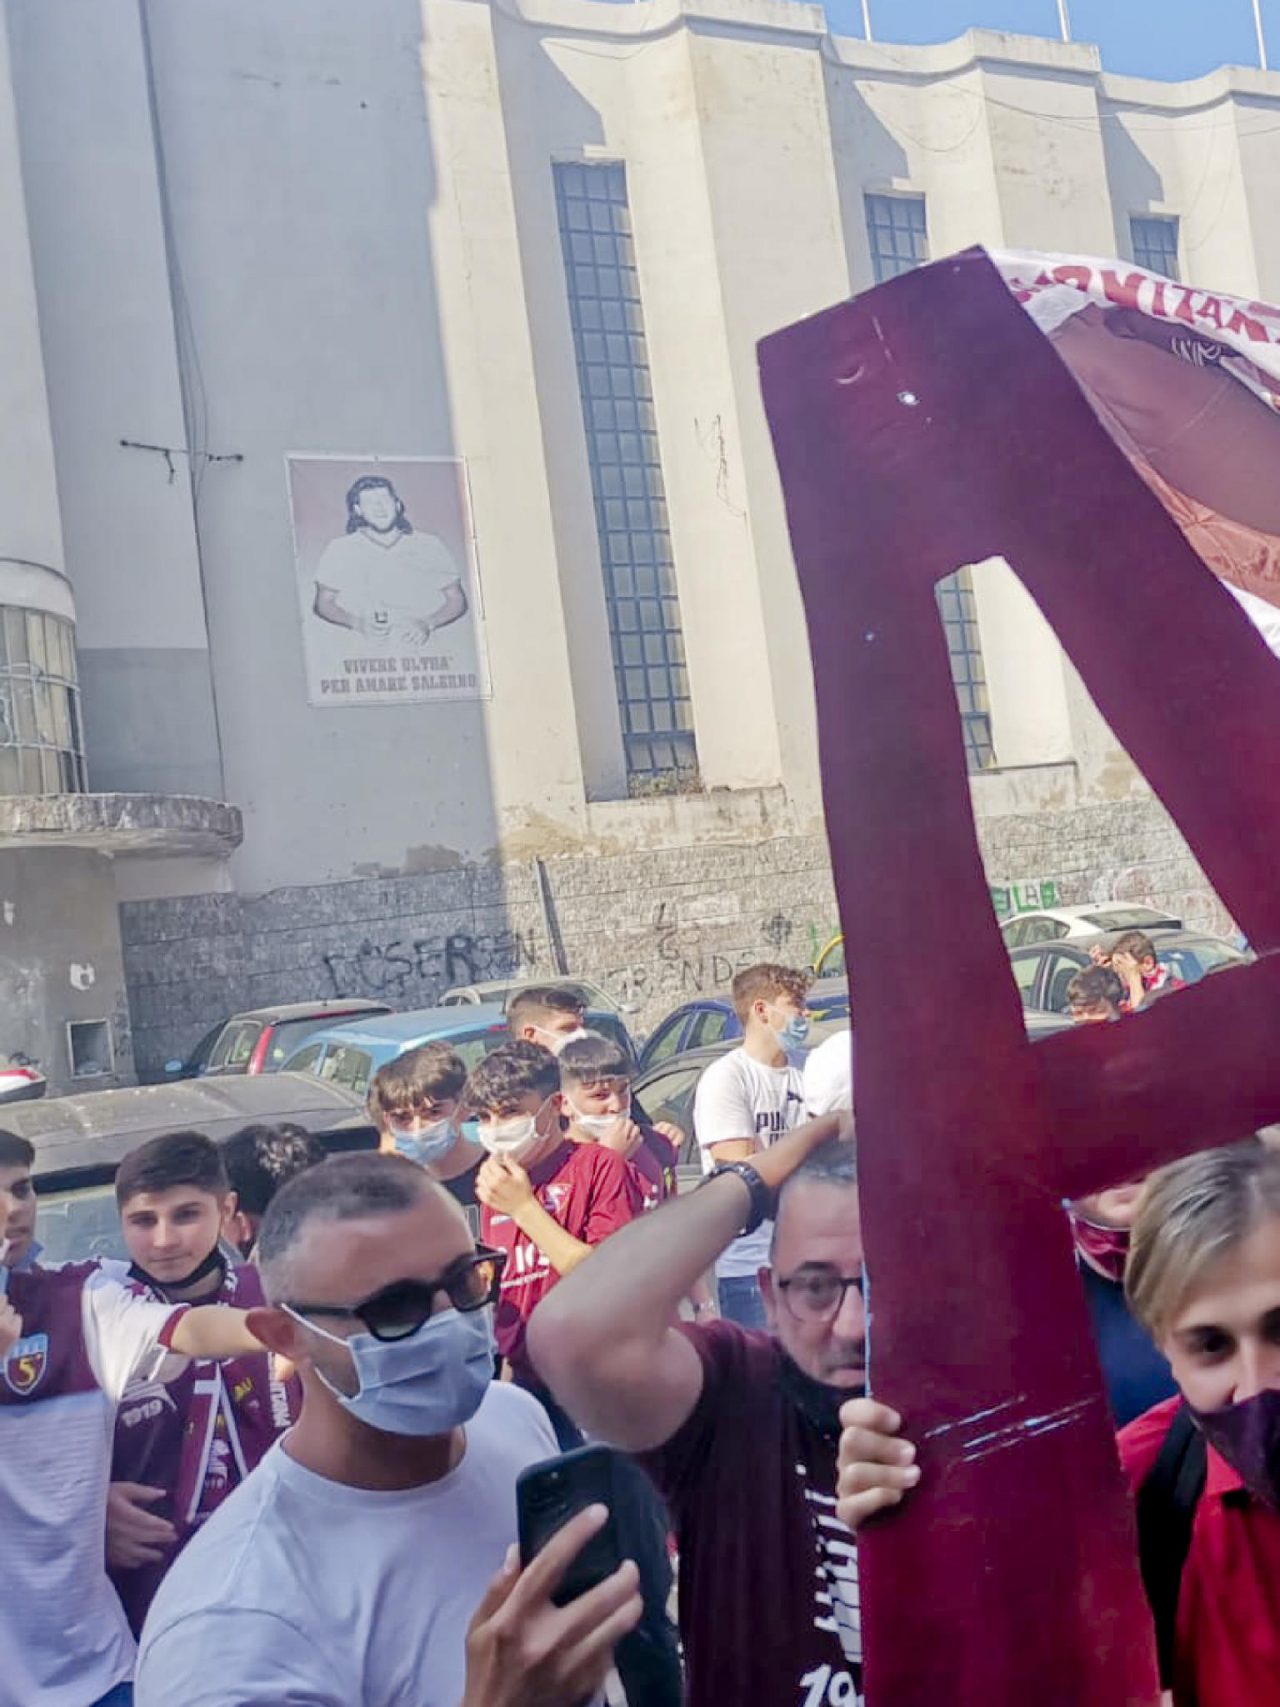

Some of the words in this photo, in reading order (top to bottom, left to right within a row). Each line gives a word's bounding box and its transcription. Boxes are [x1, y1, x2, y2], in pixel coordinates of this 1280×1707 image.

[343, 657, 398, 674] VIVERE
[320, 679, 351, 694] PER
[356, 677, 407, 693] AMARE
[411, 673, 478, 692] SALERNO
